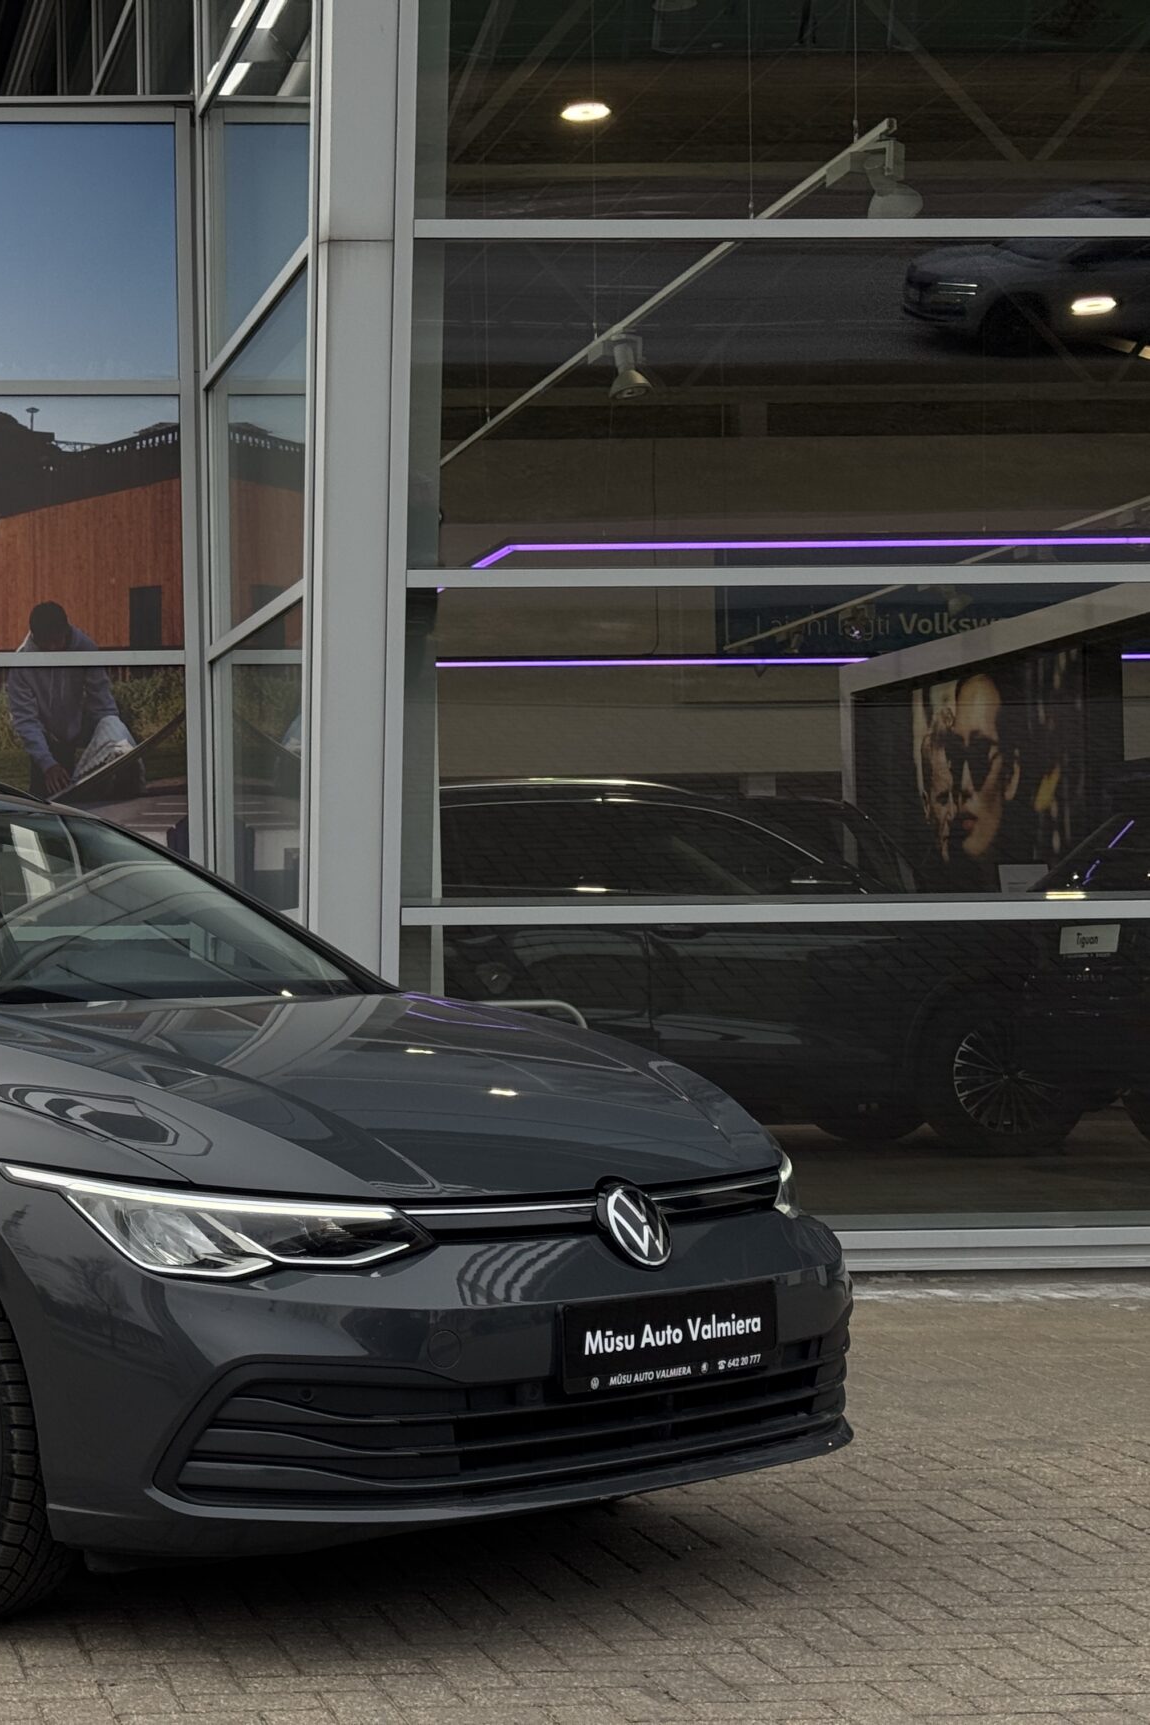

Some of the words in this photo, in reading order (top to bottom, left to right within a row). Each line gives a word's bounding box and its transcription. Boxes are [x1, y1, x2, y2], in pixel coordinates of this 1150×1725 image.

[584, 1330, 635, 1356] Mūsu
[640, 1323, 683, 1349] Auto
[687, 1313, 762, 1342] Valmiera
[633, 1370, 654, 1383] AUTO
[655, 1365, 692, 1379] VALMIERA
[749, 1353, 761, 1365] 777
